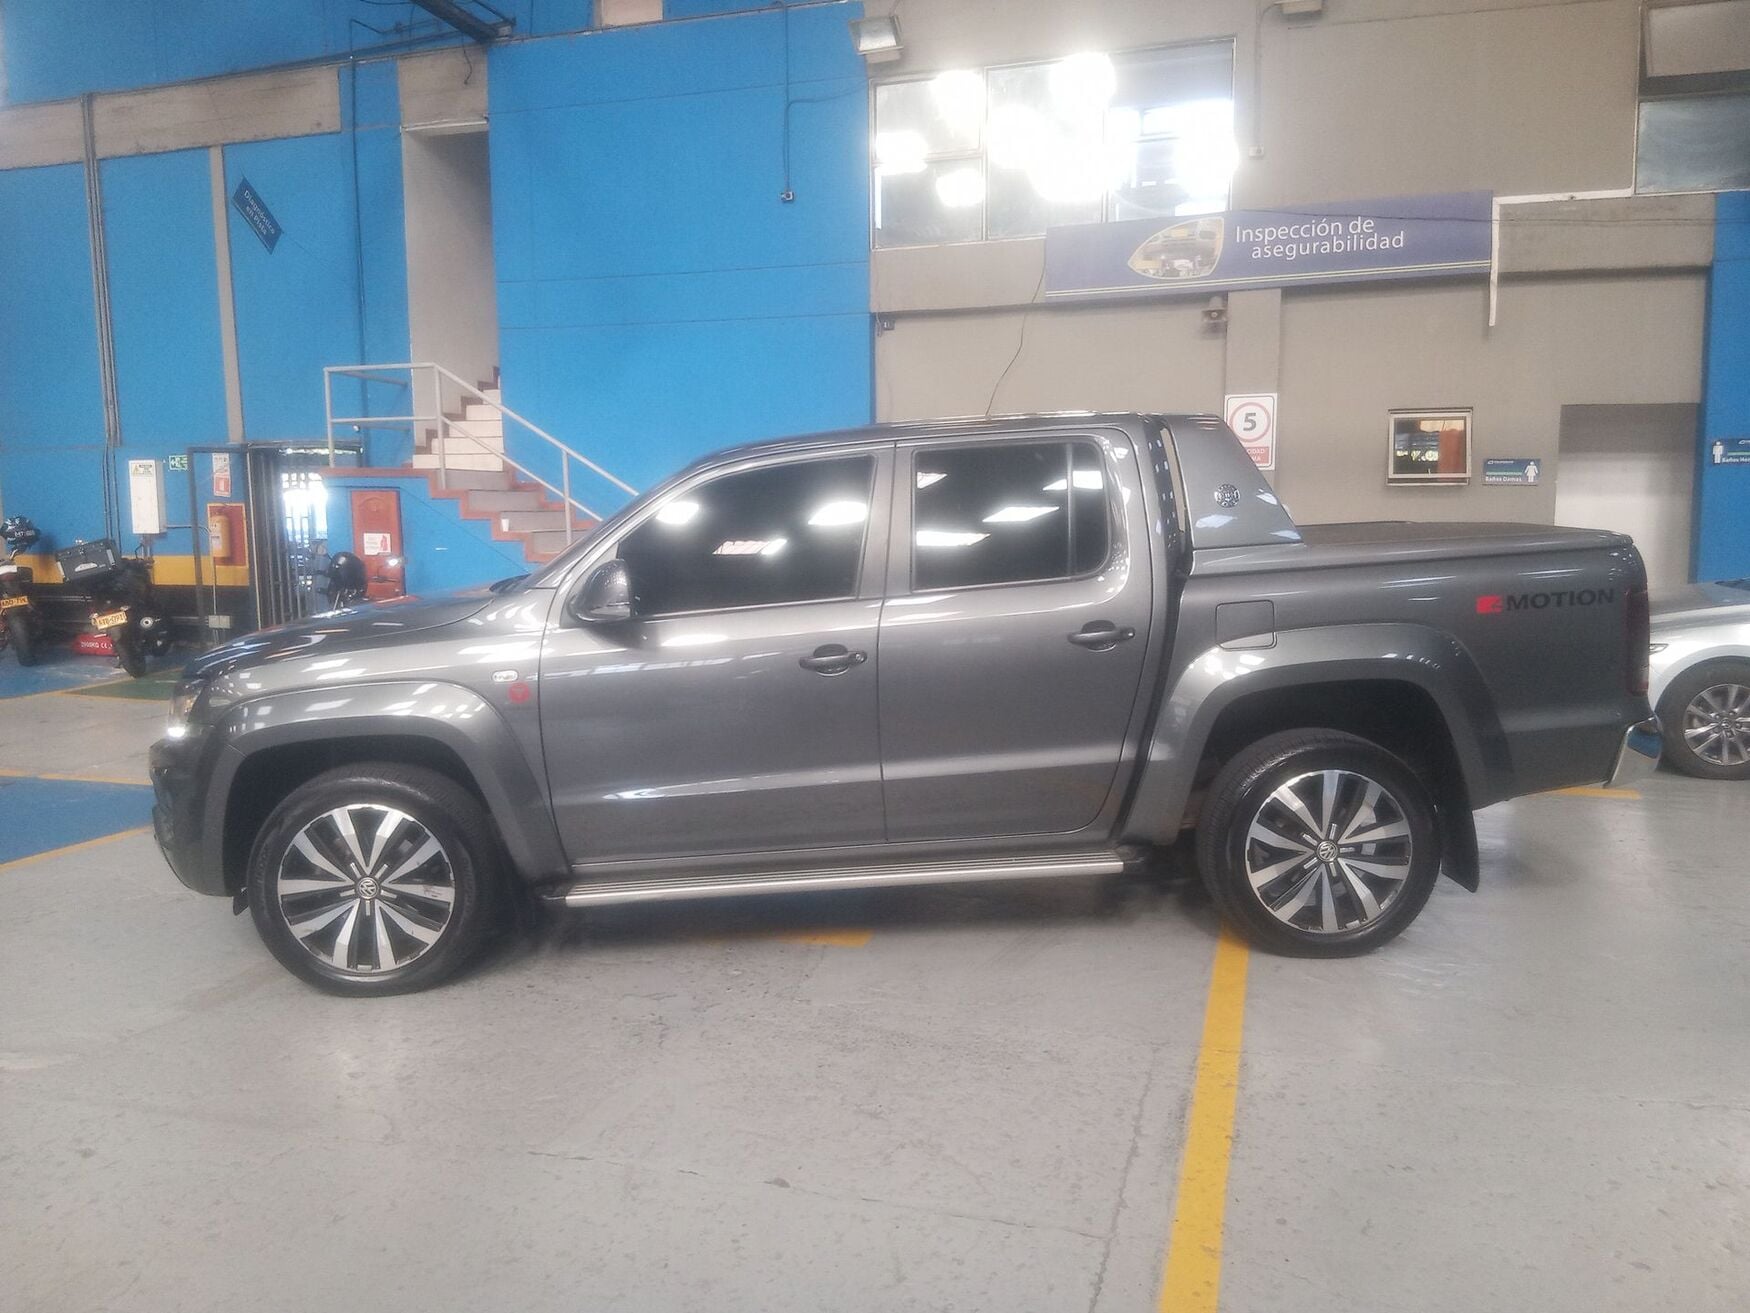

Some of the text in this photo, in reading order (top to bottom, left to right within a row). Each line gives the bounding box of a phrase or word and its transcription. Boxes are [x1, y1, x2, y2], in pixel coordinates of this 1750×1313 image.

[1236, 215, 1375, 245] Inspección de
[1251, 230, 1404, 261] asegurabilidad
[1242, 411, 1258, 432] 5
